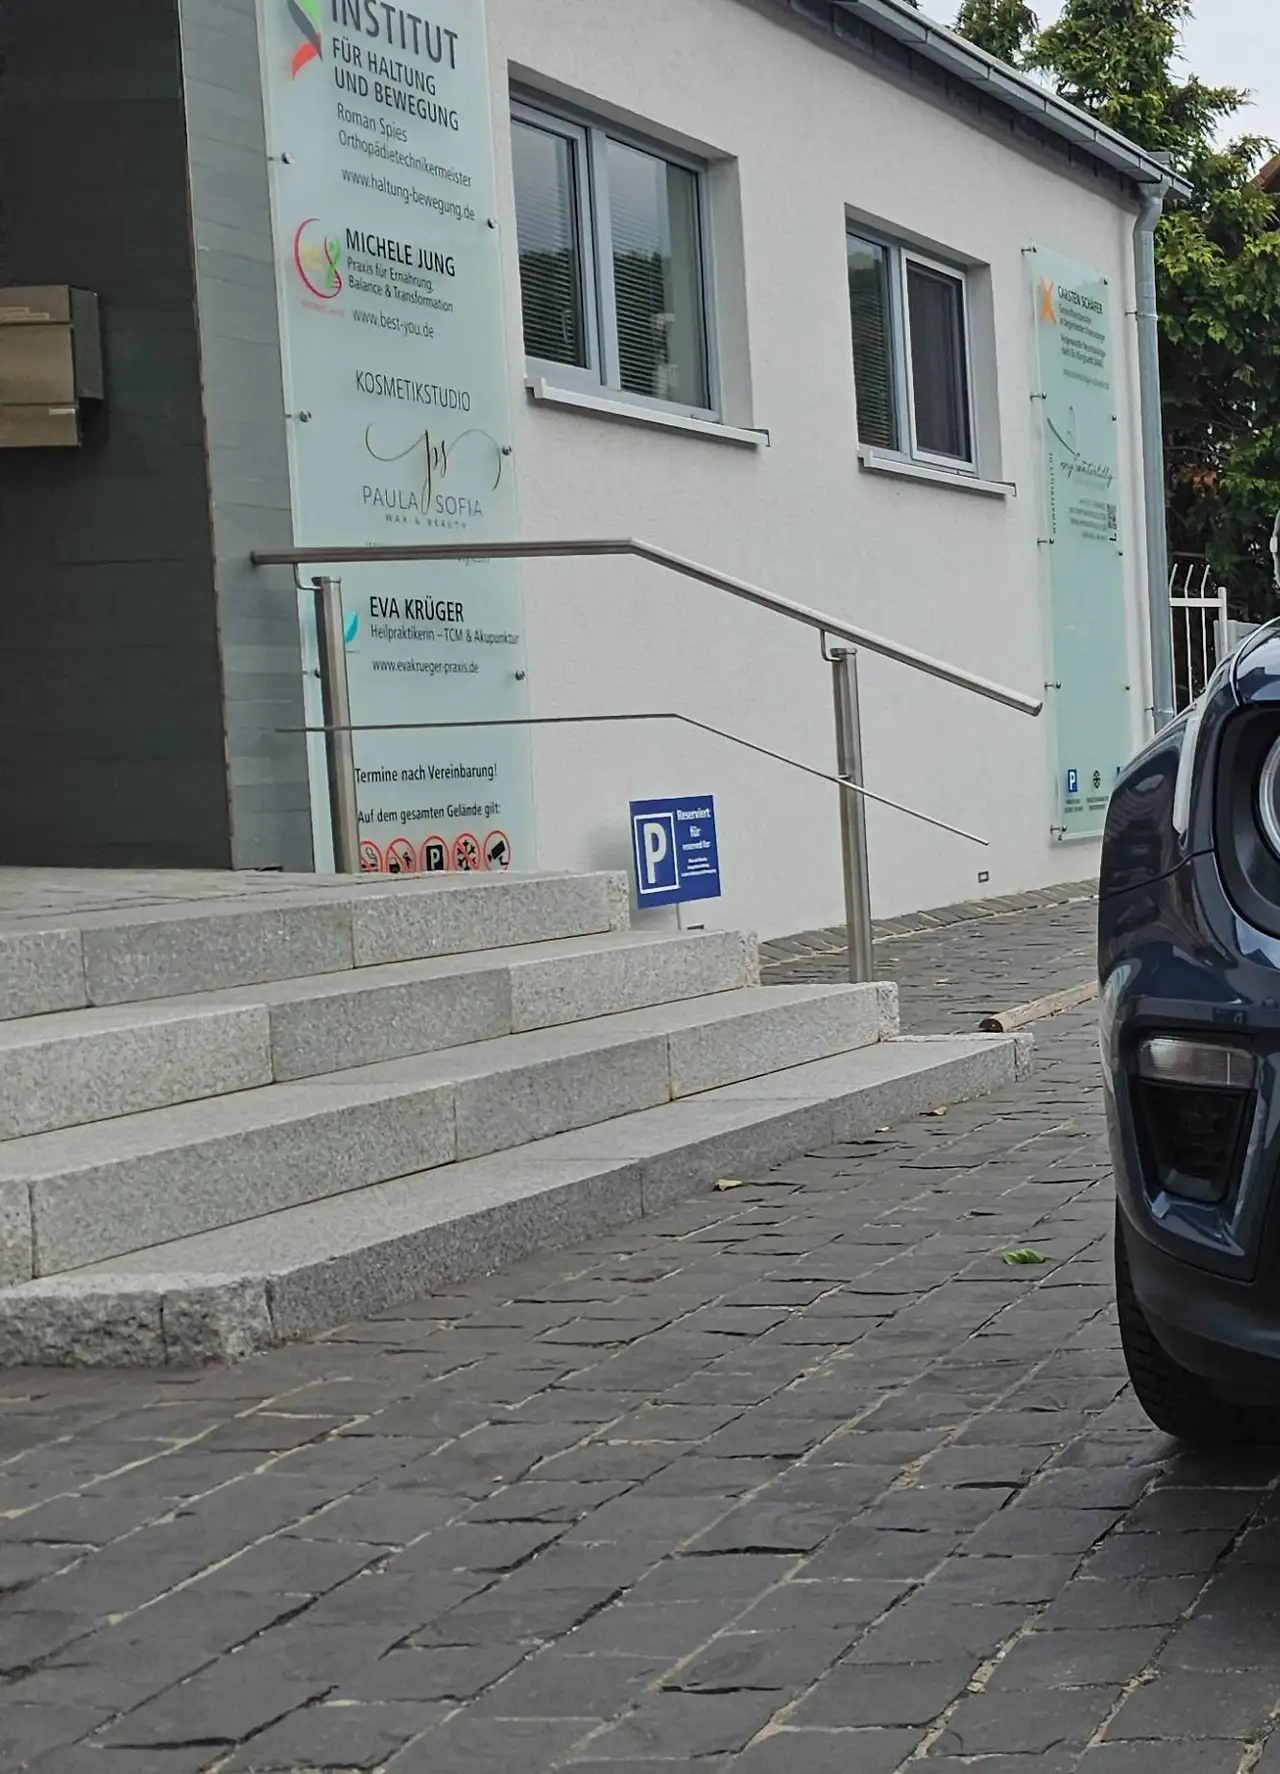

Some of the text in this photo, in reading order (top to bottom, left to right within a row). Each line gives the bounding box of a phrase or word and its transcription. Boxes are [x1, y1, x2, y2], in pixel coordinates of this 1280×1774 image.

[330, 0, 459, 69] INSTITUT
[332, 36, 437, 96] FÜR HALTUNG
[334, 67, 460, 131] UND BEWEGUNG
[337, 103, 408, 142] Roman Spies
[339, 130, 472, 187] Orthopädietechnikermeister
[342, 168, 476, 222] www.haltung-bewegung.de
[346, 228, 456, 277] MICHELE JUNG
[347, 257, 434, 293] Praxis für Ernährung,
[349, 275, 454, 313] Balance & Transformation
[352, 308, 435, 339] www.best-you.de
[356, 370, 472, 412] KOSMETIKSTUDIO
[363, 485, 484, 518] PAULA SOFIA
[370, 594, 465, 622] EVA KRÜGER
[371, 624, 435, 643] Heilpraktikerin
[444, 628, 464, 643] TCM
[466, 629, 473, 643] &
[474, 630, 520, 646] Akupunktur
[372, 658, 480, 676] www.evakrueger-praxis.de
[356, 763, 498, 784] Termine nach Vereinbarung!
[358, 802, 501, 824] Auf dem gesamten Gelände gilt:
[677, 807, 712, 821] Reserviert
[644, 823, 667, 884] P
